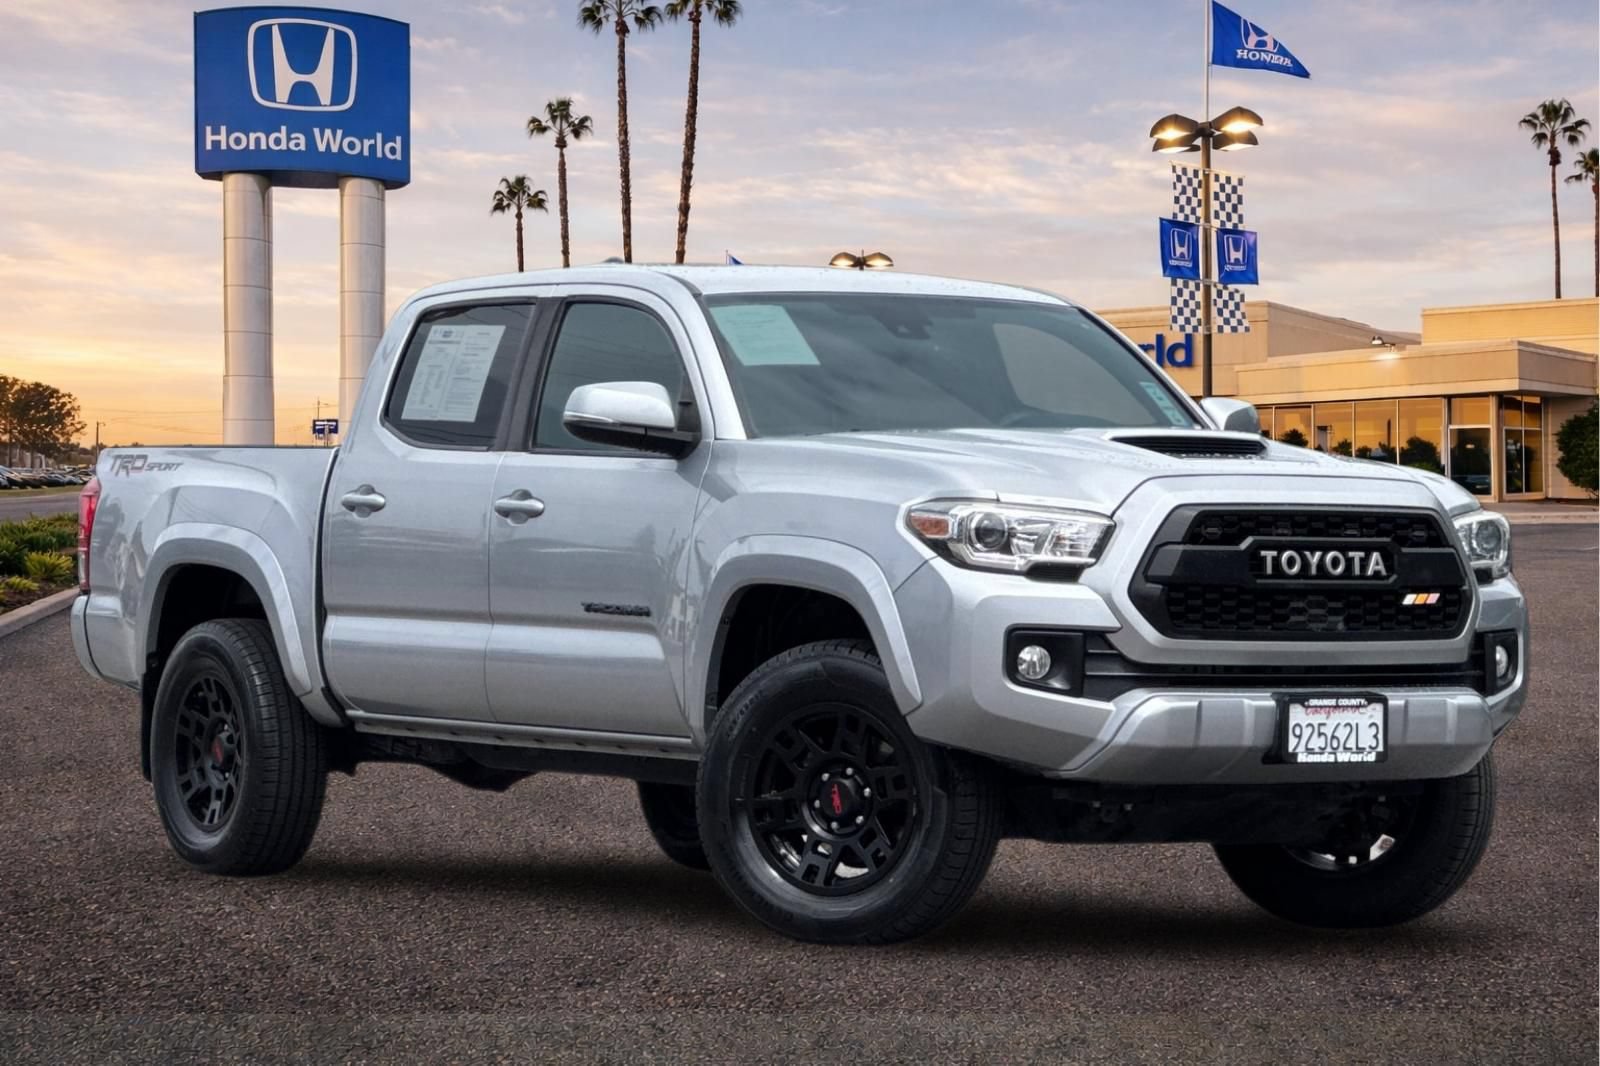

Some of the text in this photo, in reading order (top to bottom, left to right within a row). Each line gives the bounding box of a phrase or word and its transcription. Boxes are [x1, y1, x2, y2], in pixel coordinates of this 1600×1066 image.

[205, 125, 403, 160] Honda World
[1260, 550, 1387, 576] TOYOTA
[1338, 698, 1365, 706] COUNTY
[1291, 722, 1380, 752] 92562L3
[1297, 751, 1376, 763] Honda World
